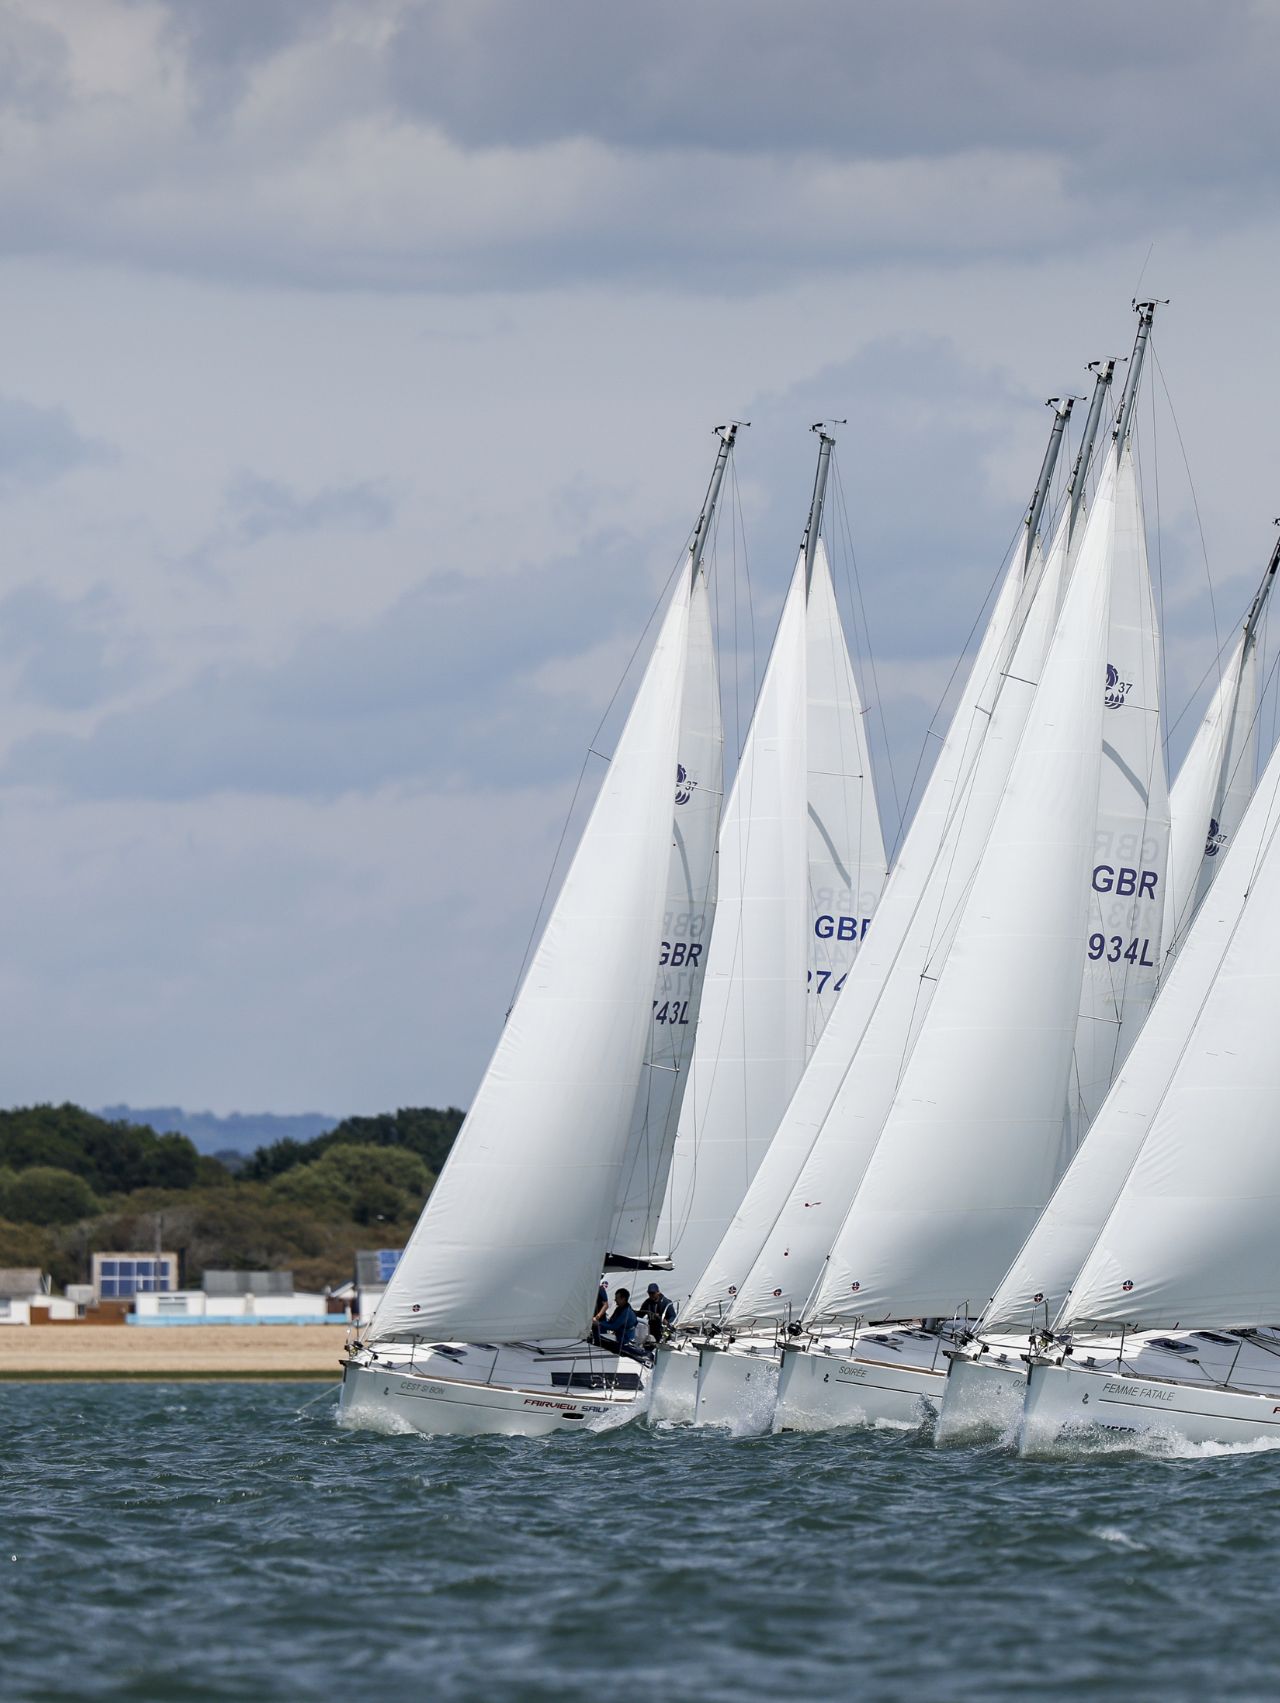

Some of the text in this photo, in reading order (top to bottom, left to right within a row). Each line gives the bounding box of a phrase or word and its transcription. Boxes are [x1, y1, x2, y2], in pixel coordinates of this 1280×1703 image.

[1118, 682, 1133, 694] 37
[685, 780, 698, 791] 37
[1216, 834, 1228, 844] 37
[1092, 864, 1159, 900] GBR
[659, 941, 703, 968] GBR
[1088, 932, 1154, 967] 934L
[838, 1365, 868, 1378] SOIRÉE
[1102, 1382, 1176, 1402] FEMME FATALE
[523, 1398, 577, 1411] FAIRVIEW
